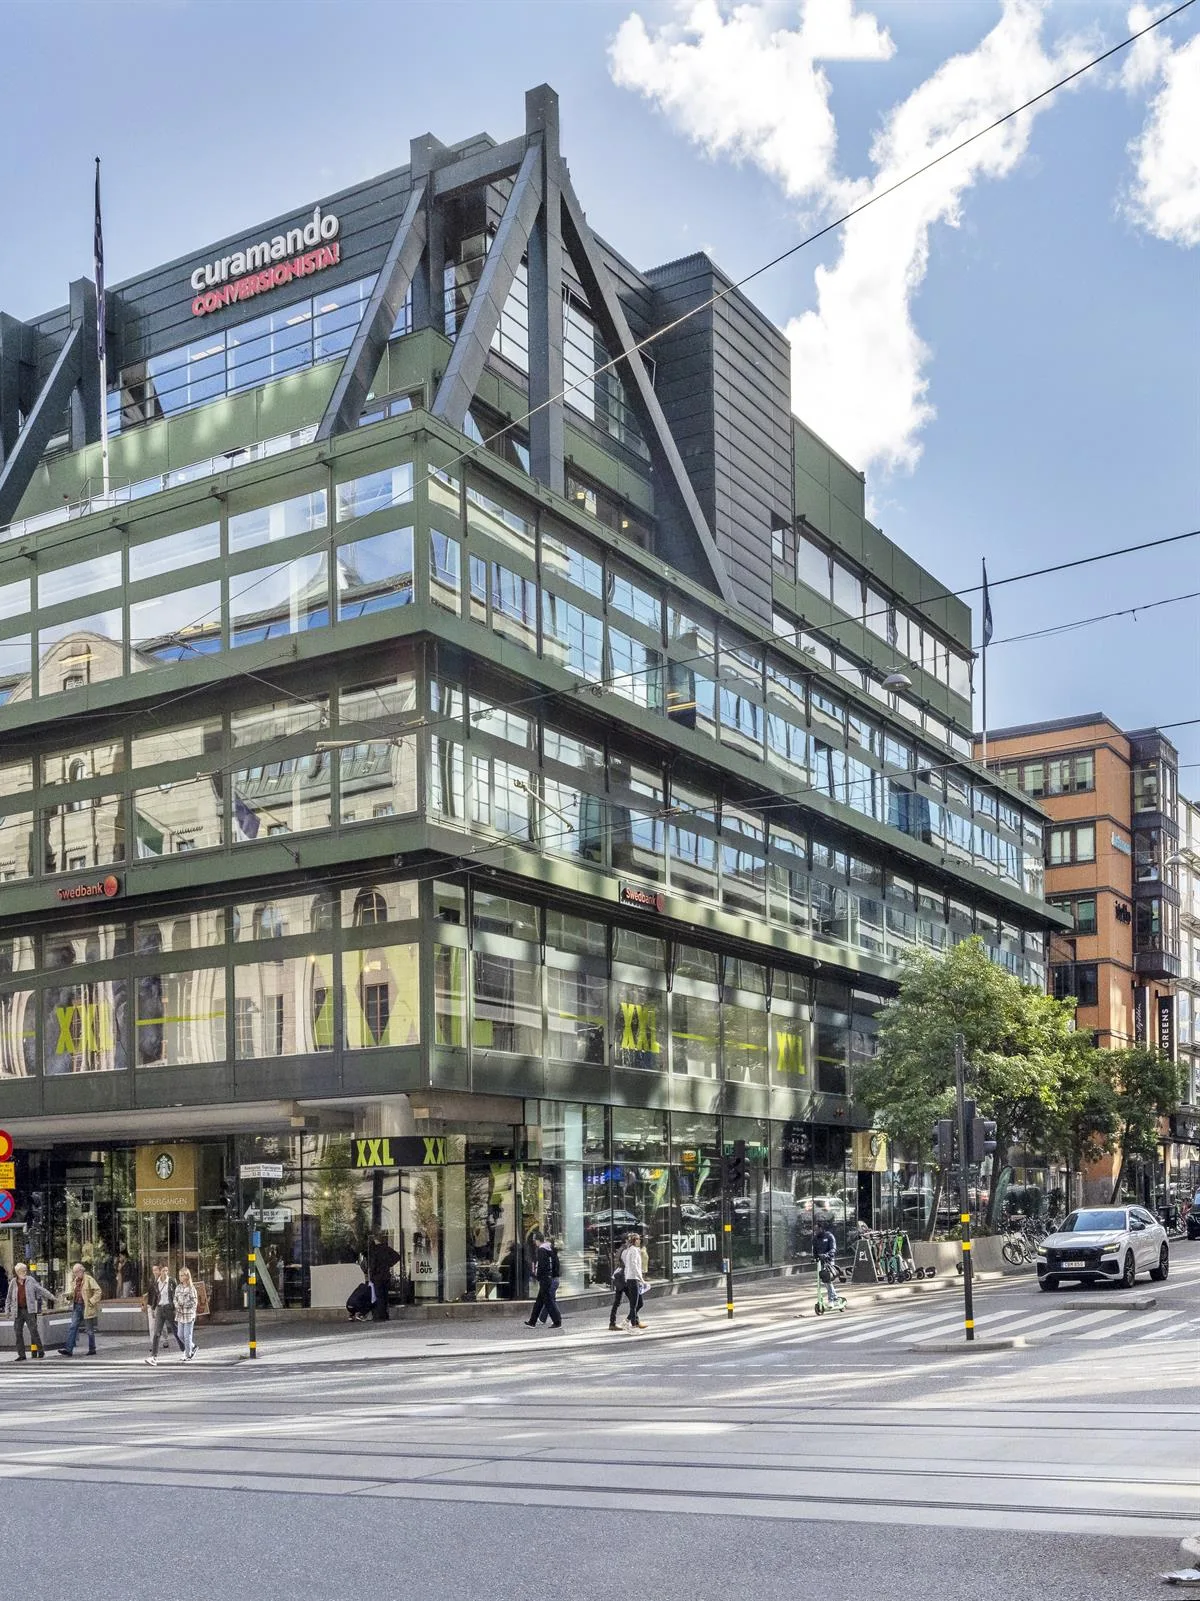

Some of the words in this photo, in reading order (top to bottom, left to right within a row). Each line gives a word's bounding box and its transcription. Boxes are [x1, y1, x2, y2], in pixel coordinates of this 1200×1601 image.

[190, 206, 340, 291] curamando
[191, 242, 341, 317] CONVERSIONISTA!
[57, 883, 104, 900] Swedbank
[621, 1002, 660, 1053] XXL
[1161, 1008, 1169, 1048] GREENS
[356, 1138, 394, 1167] XXL
[672, 1230, 717, 1253] stadium
[673, 1258, 691, 1269] OUTLET
